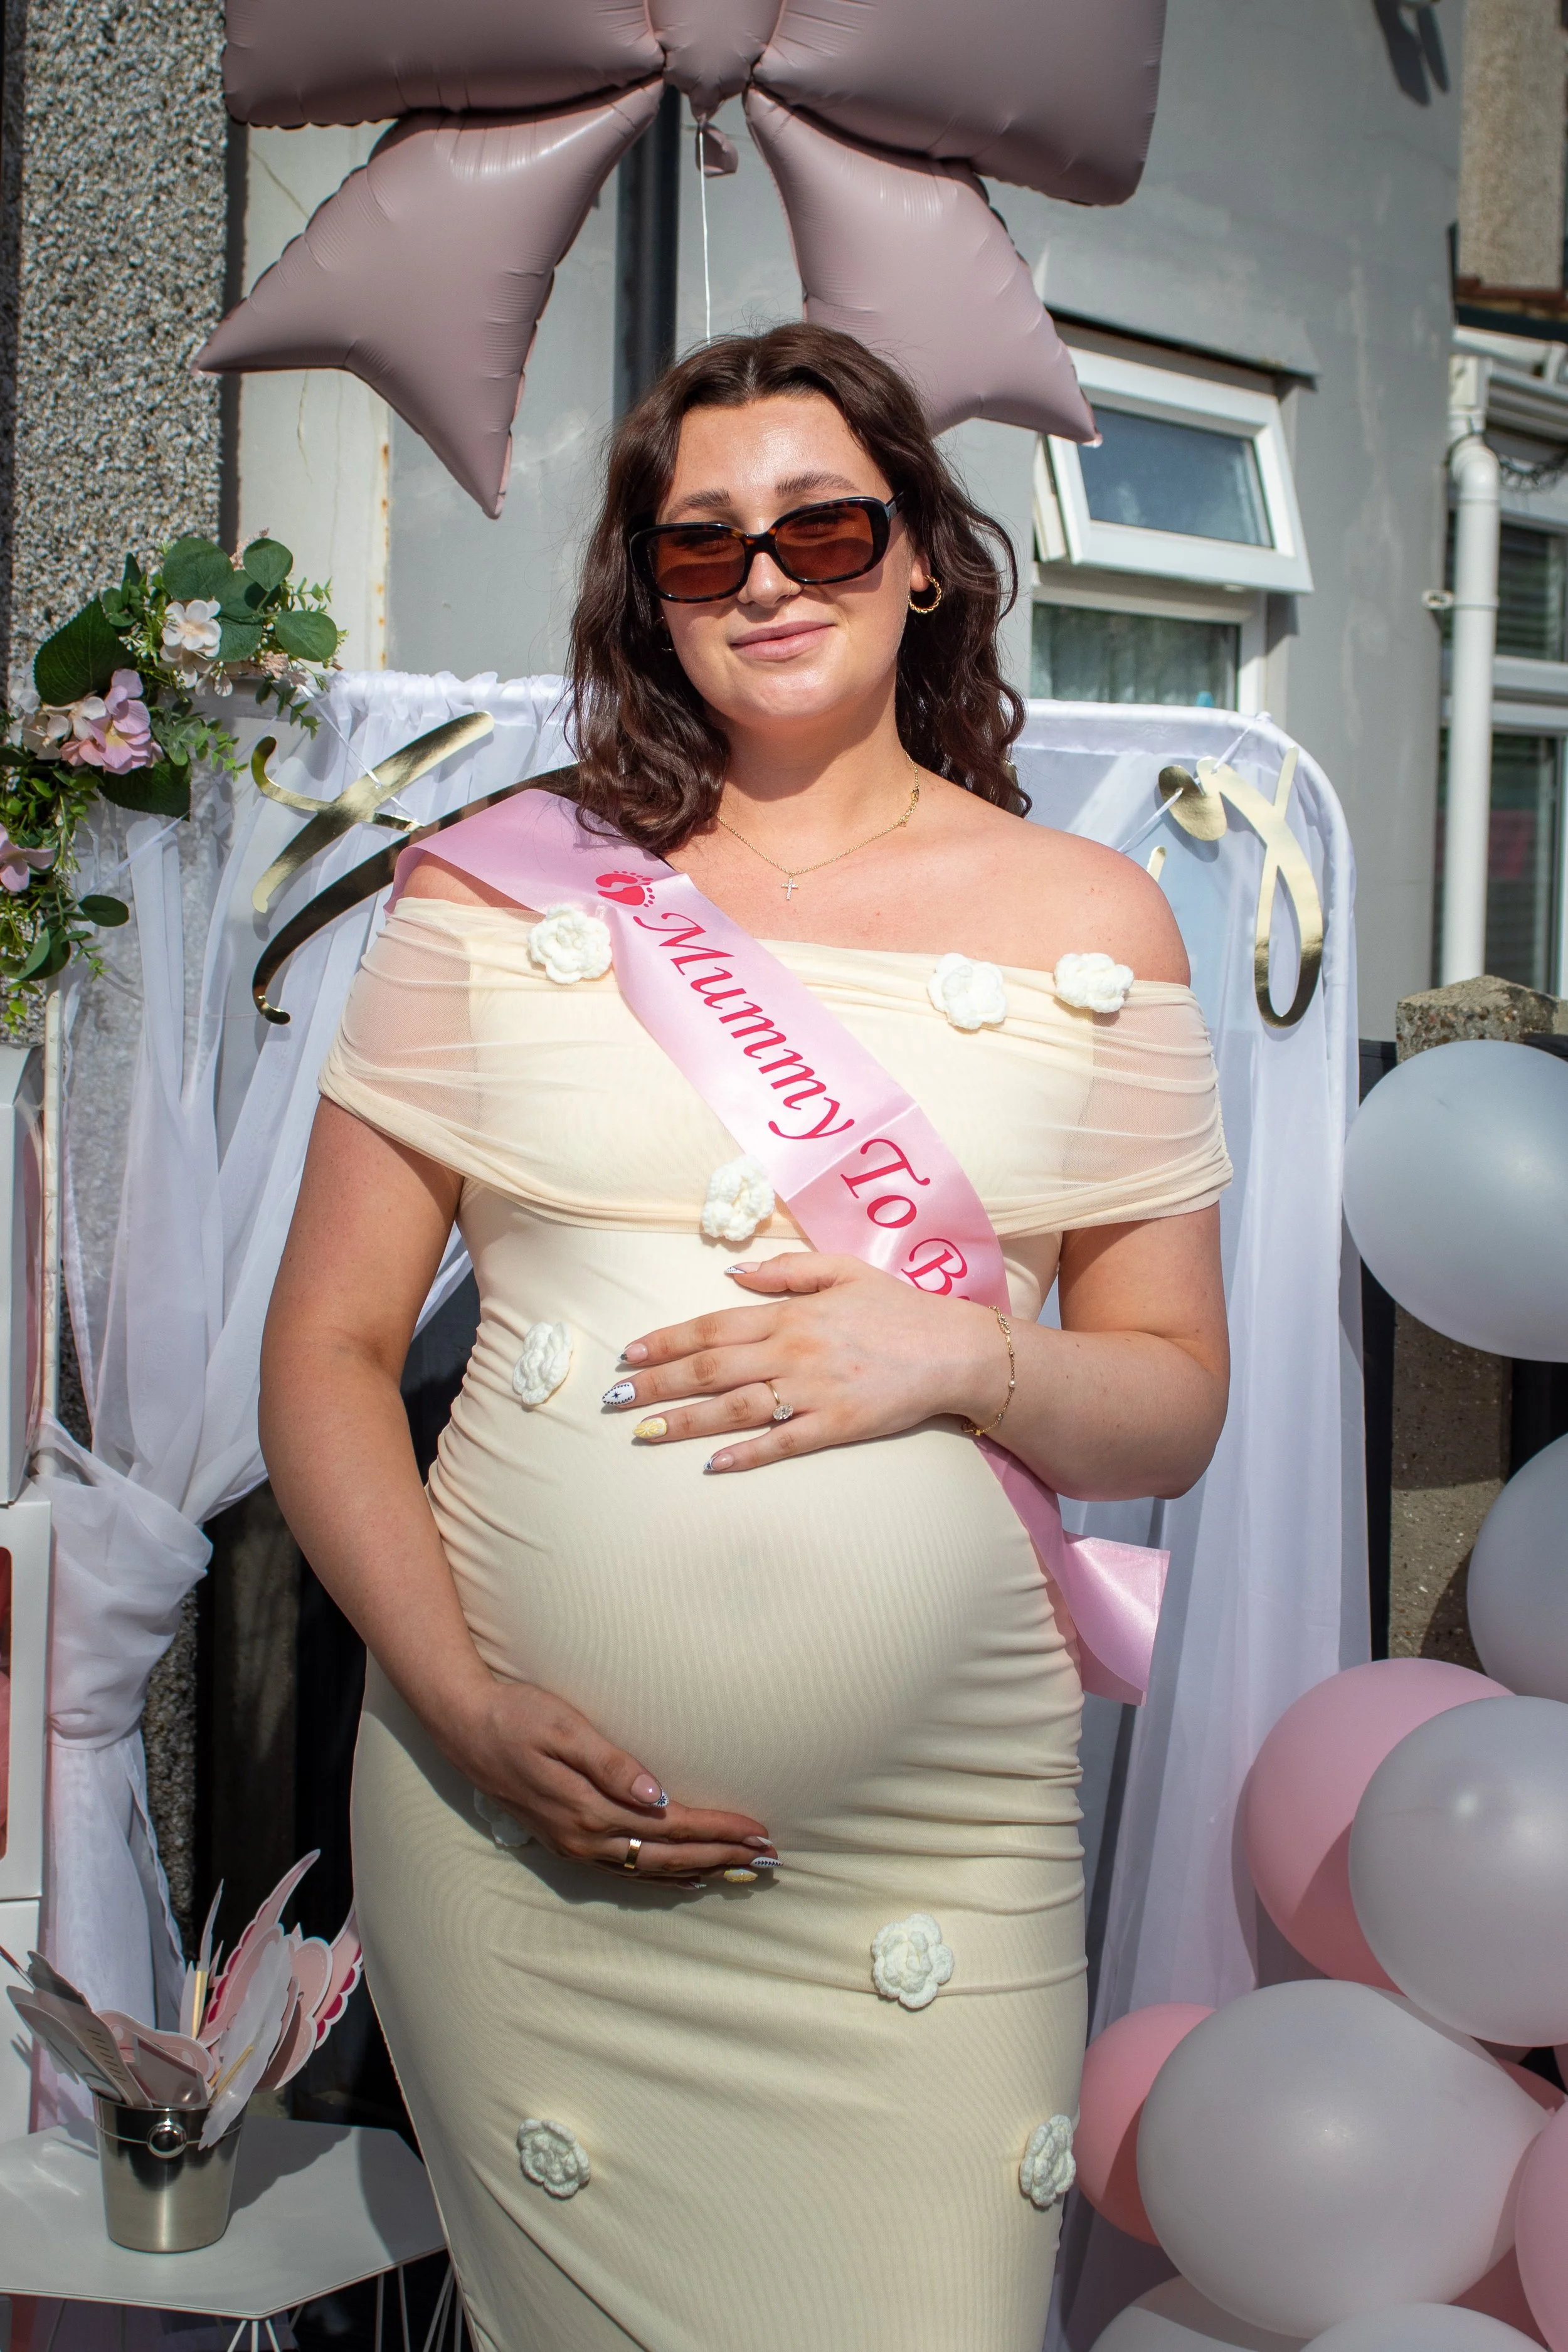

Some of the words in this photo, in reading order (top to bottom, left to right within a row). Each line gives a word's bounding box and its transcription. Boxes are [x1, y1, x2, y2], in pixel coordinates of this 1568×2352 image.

[633, 913, 856, 1140] Mummy
[840, 1138, 931, 1229] To
[901, 1237, 972, 1301] B
